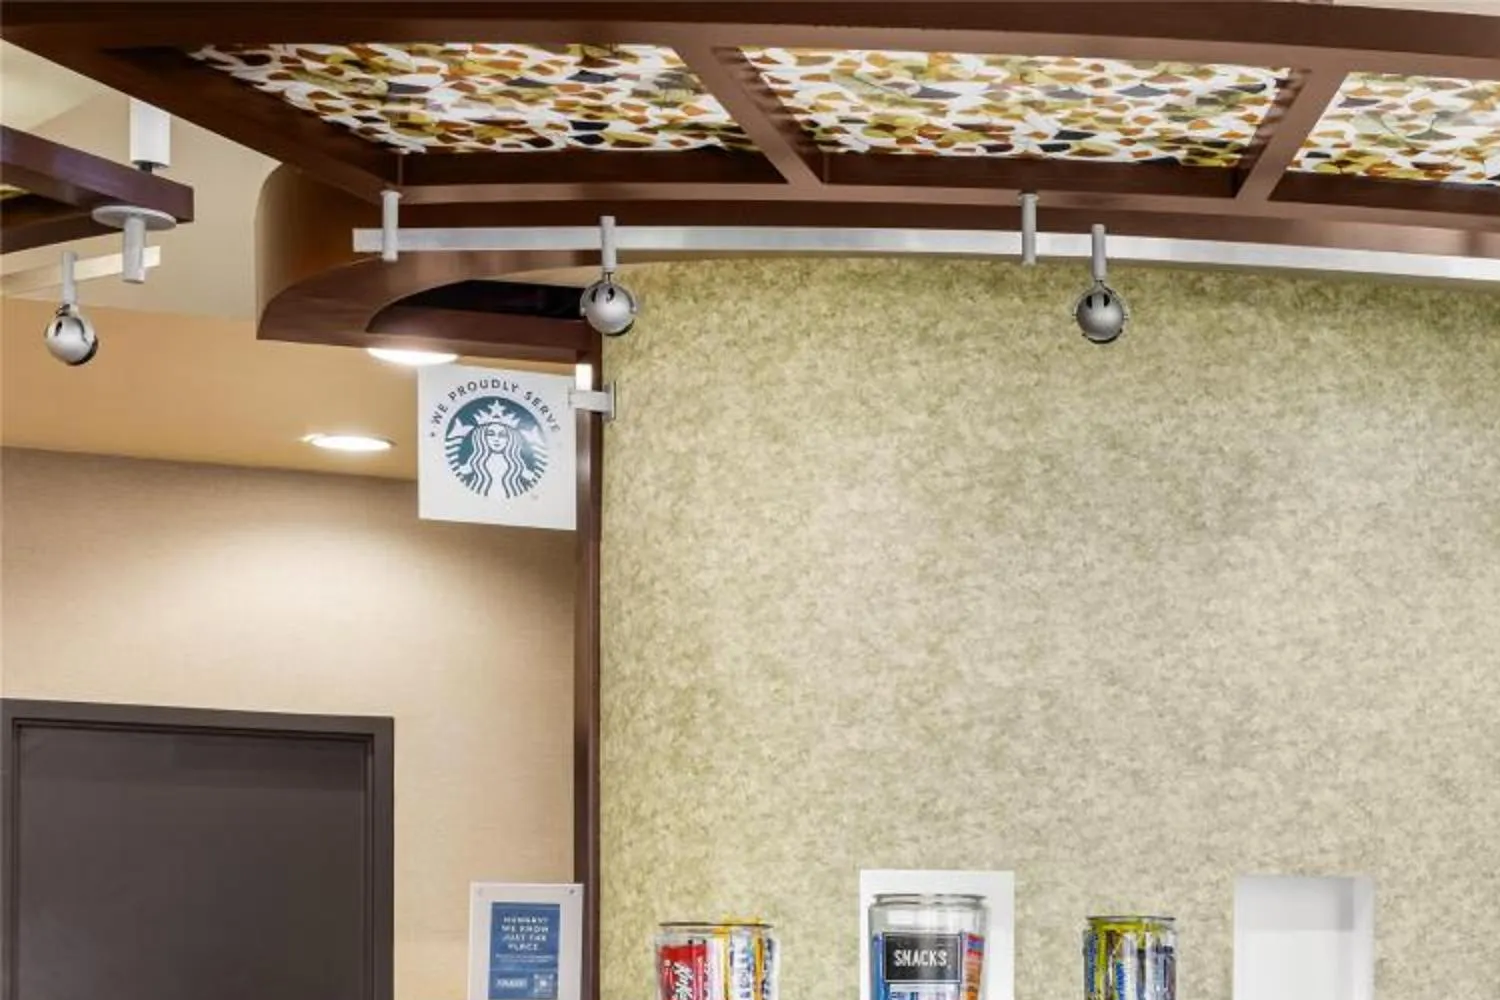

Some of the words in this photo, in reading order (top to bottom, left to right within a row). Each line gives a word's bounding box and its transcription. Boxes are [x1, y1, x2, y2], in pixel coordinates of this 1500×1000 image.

[431, 403, 449, 425] WE
[448, 378, 520, 401] PROUDLY
[523, 390, 561, 434] SERVE
